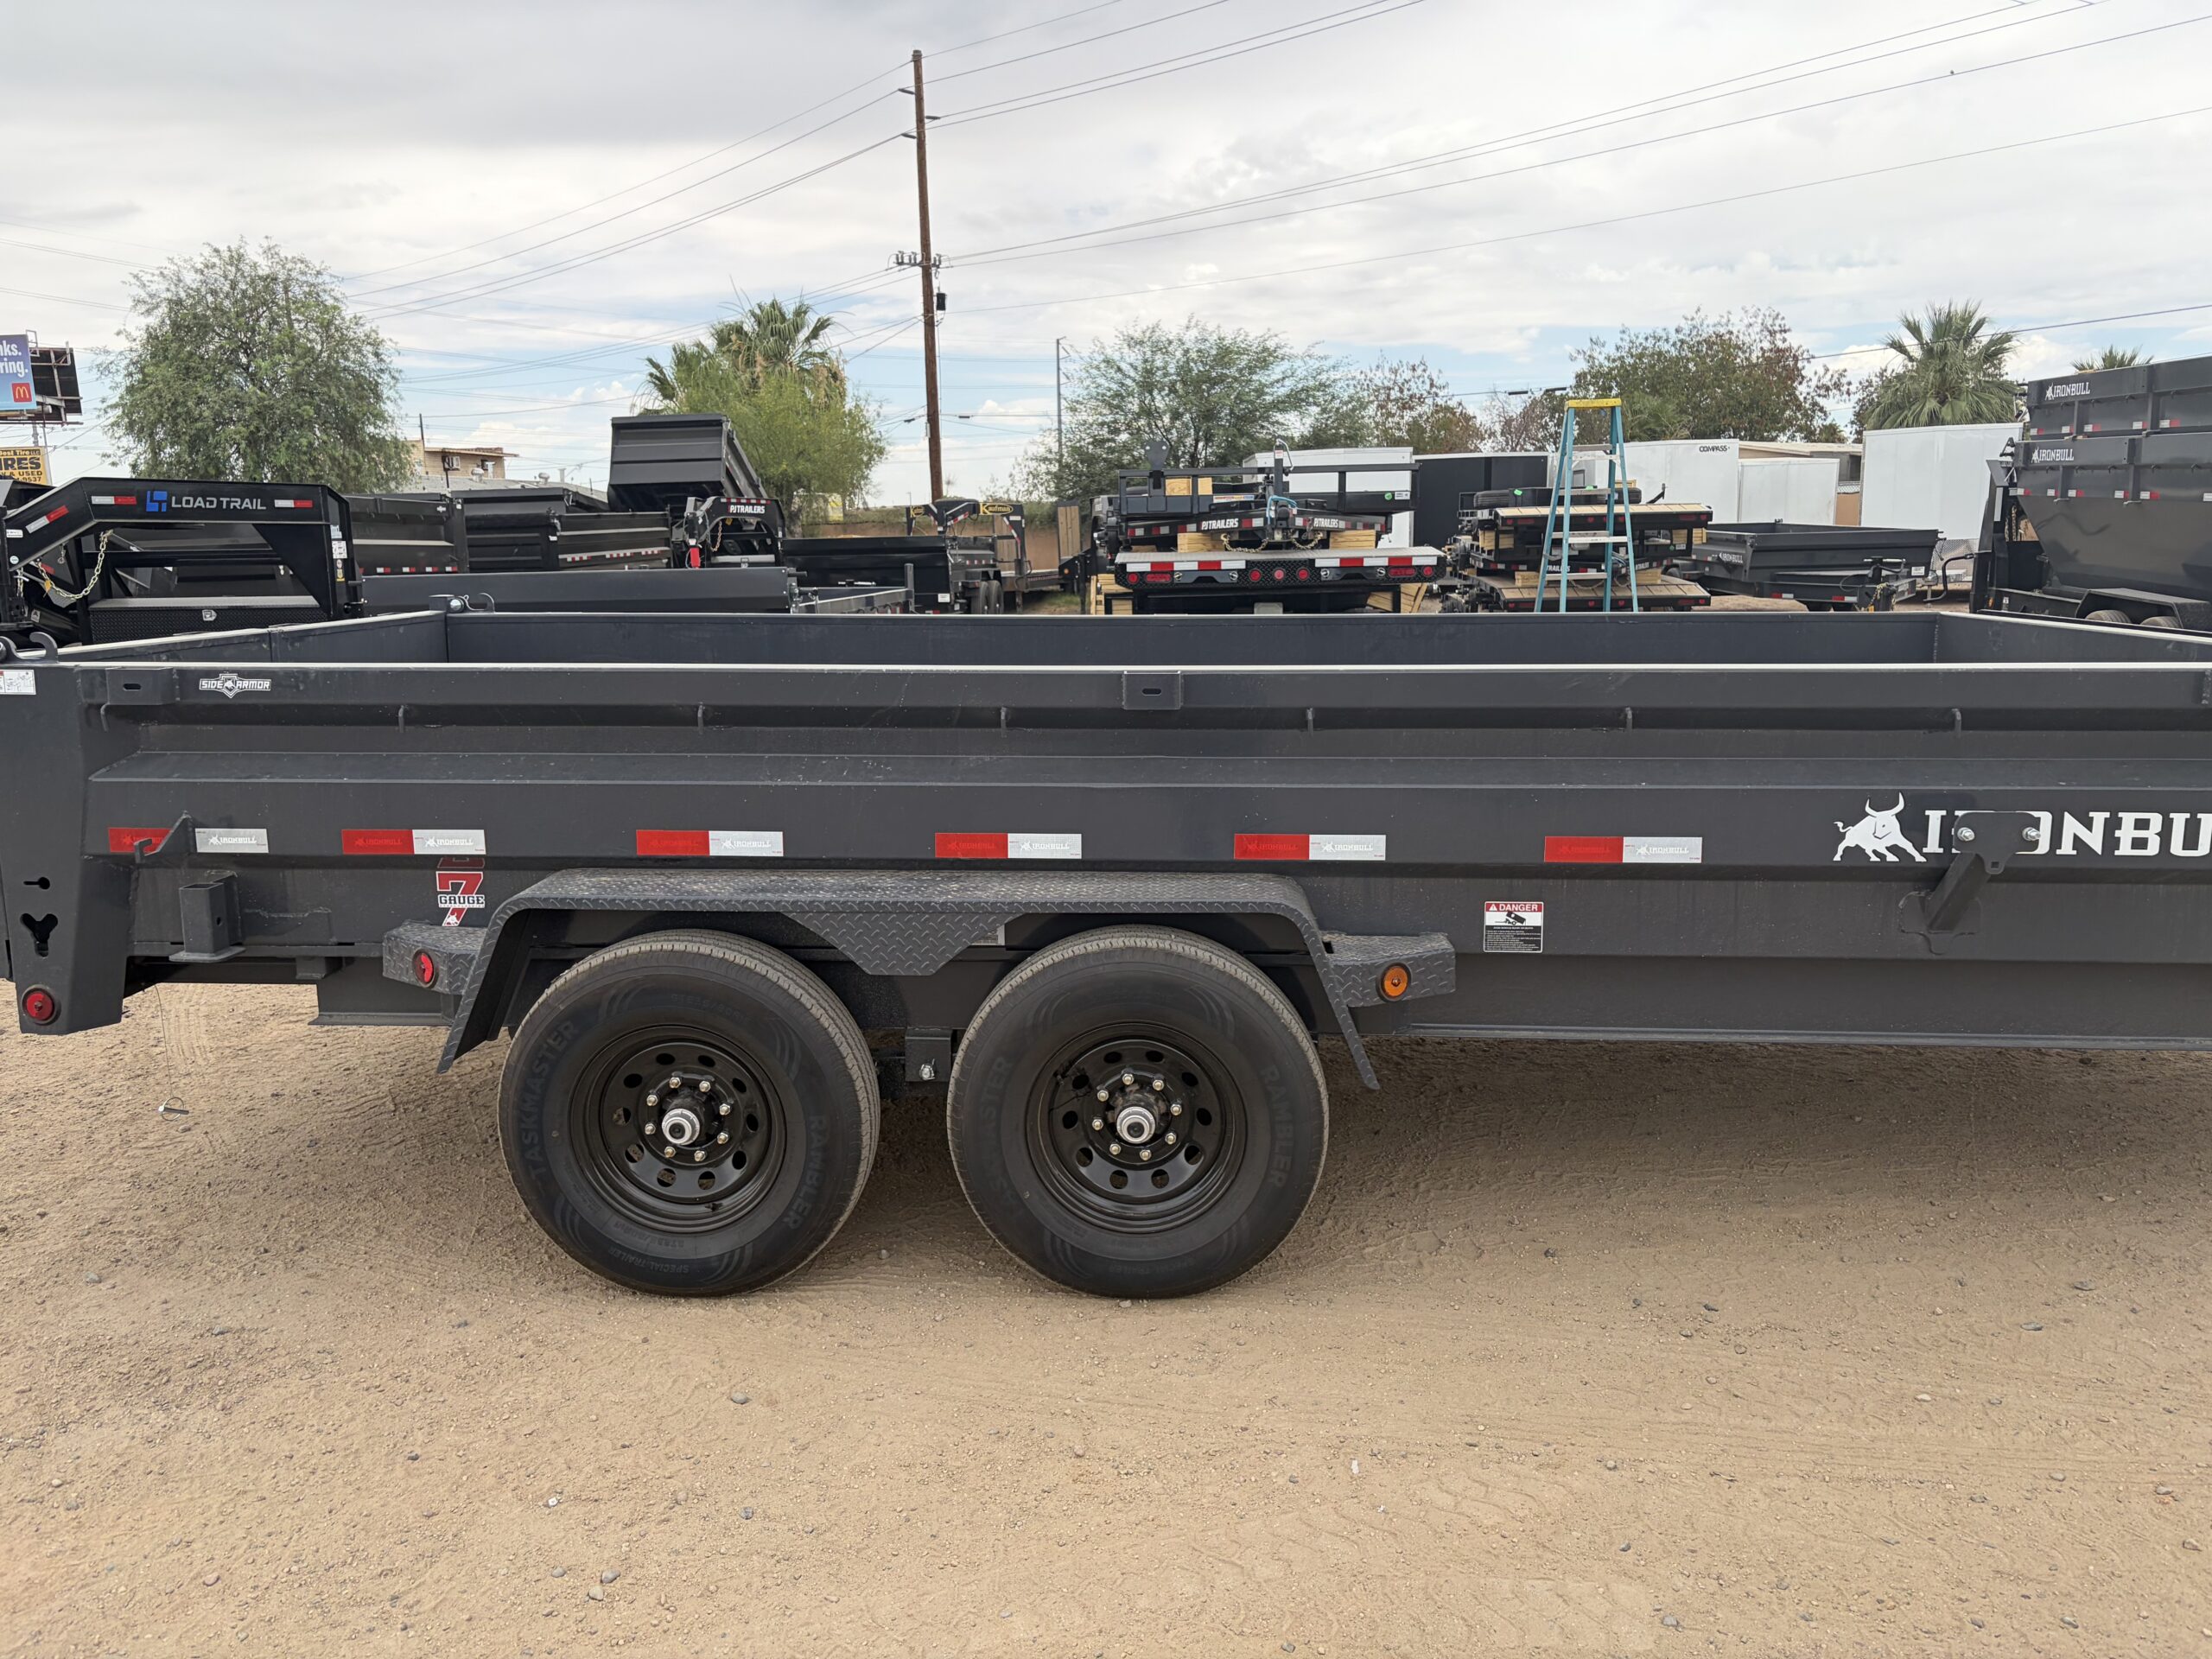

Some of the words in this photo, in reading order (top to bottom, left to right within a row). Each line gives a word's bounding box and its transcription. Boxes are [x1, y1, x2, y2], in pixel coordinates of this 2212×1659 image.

[2053, 382, 2091, 397] IRONBULL
[2039, 448, 2075, 461] IRONBULL
[171, 496, 218, 509] LOAD
[219, 497, 267, 510] TRAIL
[201, 680, 224, 689] SIDE
[236, 680, 270, 690] ARMOR
[1923, 810, 2212, 857] INBU
[435, 871, 484, 927] 7
[439, 895, 485, 906] GAUGE
[519, 1020, 581, 1180] TASKMASTER
[1260, 1065, 1294, 1188] RAMBLER
[781, 1115, 829, 1230] RAMBLER
